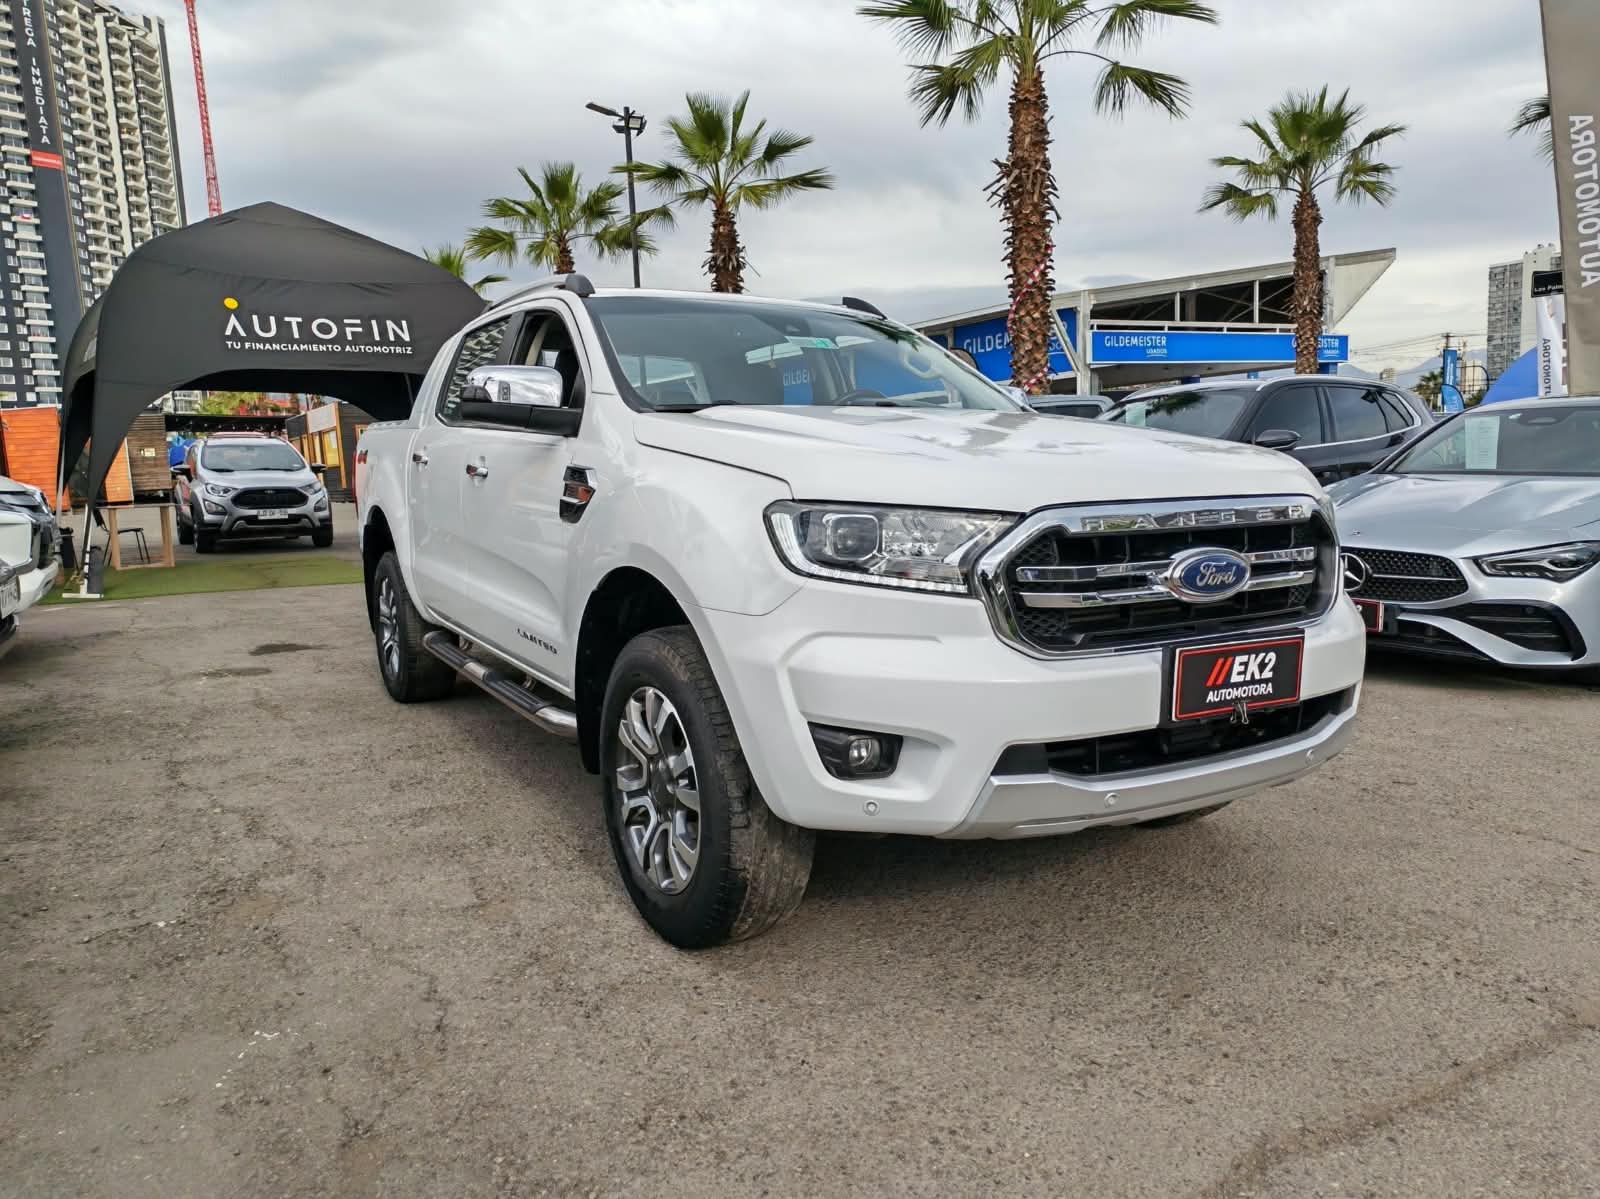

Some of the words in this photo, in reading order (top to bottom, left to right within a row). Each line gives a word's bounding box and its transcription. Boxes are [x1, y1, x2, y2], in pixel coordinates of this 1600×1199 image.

[31, 57, 50, 145] INMEDIATA
[225, 313, 411, 342] AUTOFIN
[226, 341, 241, 350] TU
[245, 342, 341, 352] FINANCIAMIENTO
[345, 344, 413, 354] AUTOMOTRIZ
[1104, 335, 1167, 347] GILDEMEISTER
[1196, 561, 1236, 587] Ford
[1206, 682, 1273, 703] AUTOMOTORA
